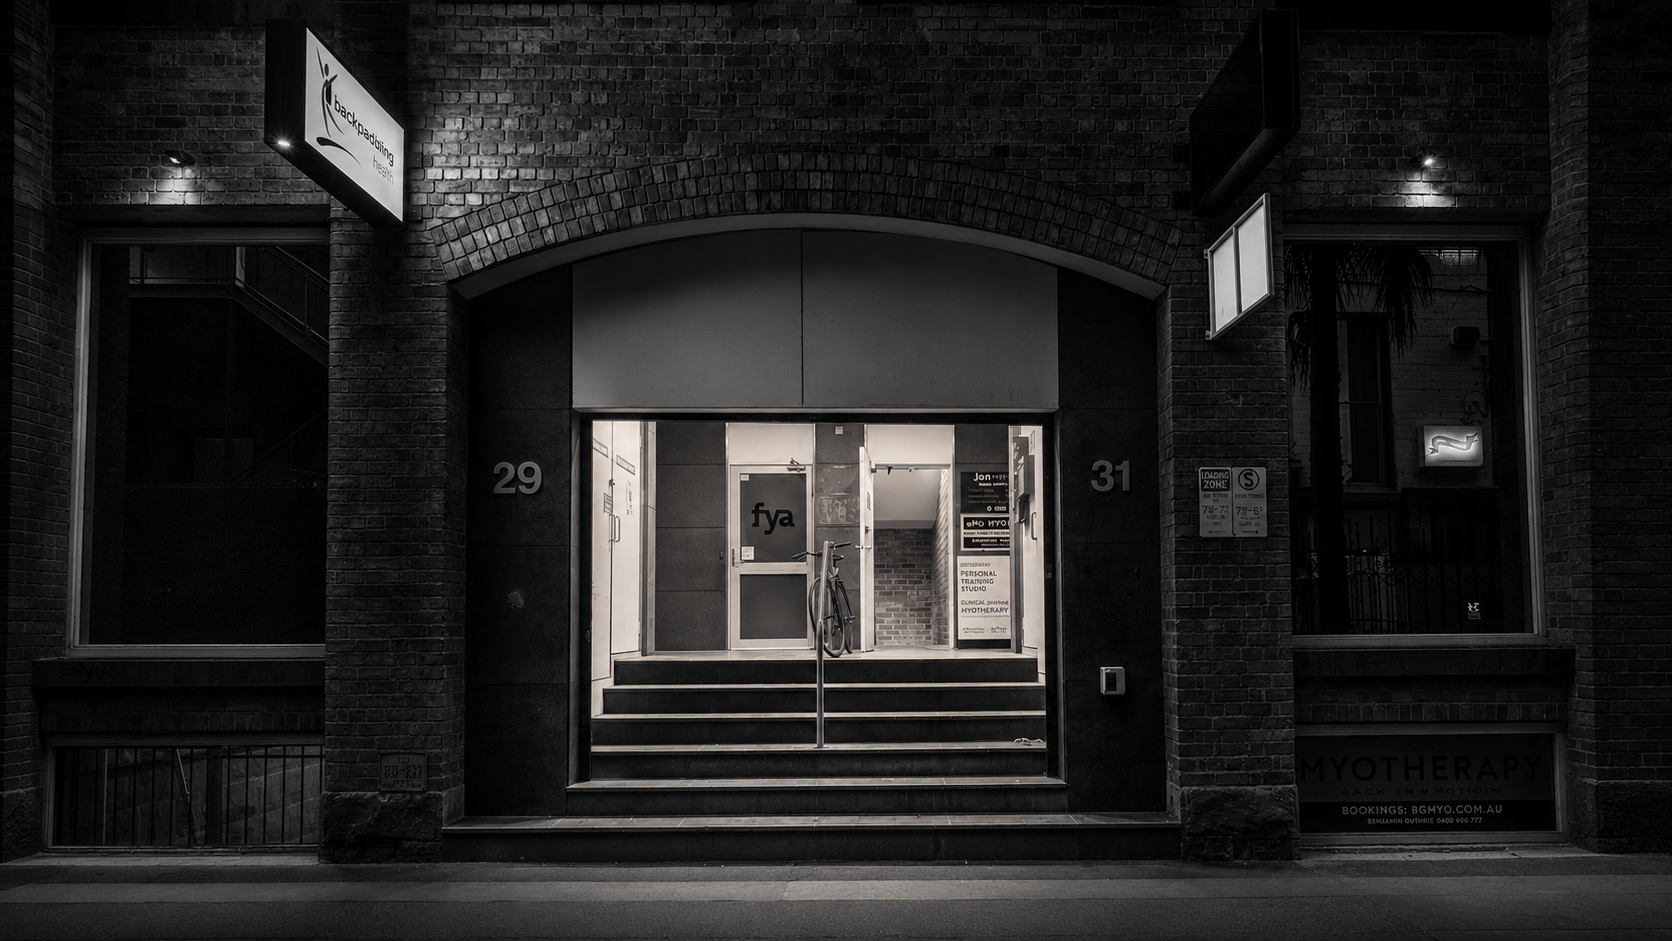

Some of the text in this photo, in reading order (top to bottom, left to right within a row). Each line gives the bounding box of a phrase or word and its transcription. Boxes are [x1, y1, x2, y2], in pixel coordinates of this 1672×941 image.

[372, 154, 394, 185] health
[492, 461, 542, 495] 29
[1091, 460, 1130, 492] 31
[1203, 480, 1228, 489] ZONE
[751, 502, 795, 535] fya
[1300, 755, 1543, 782] MYOTHERAPY
[1342, 788, 1386, 796] BACK
[1341, 804, 1503, 816] BOOKINGS: BGMYO.COM.AU
